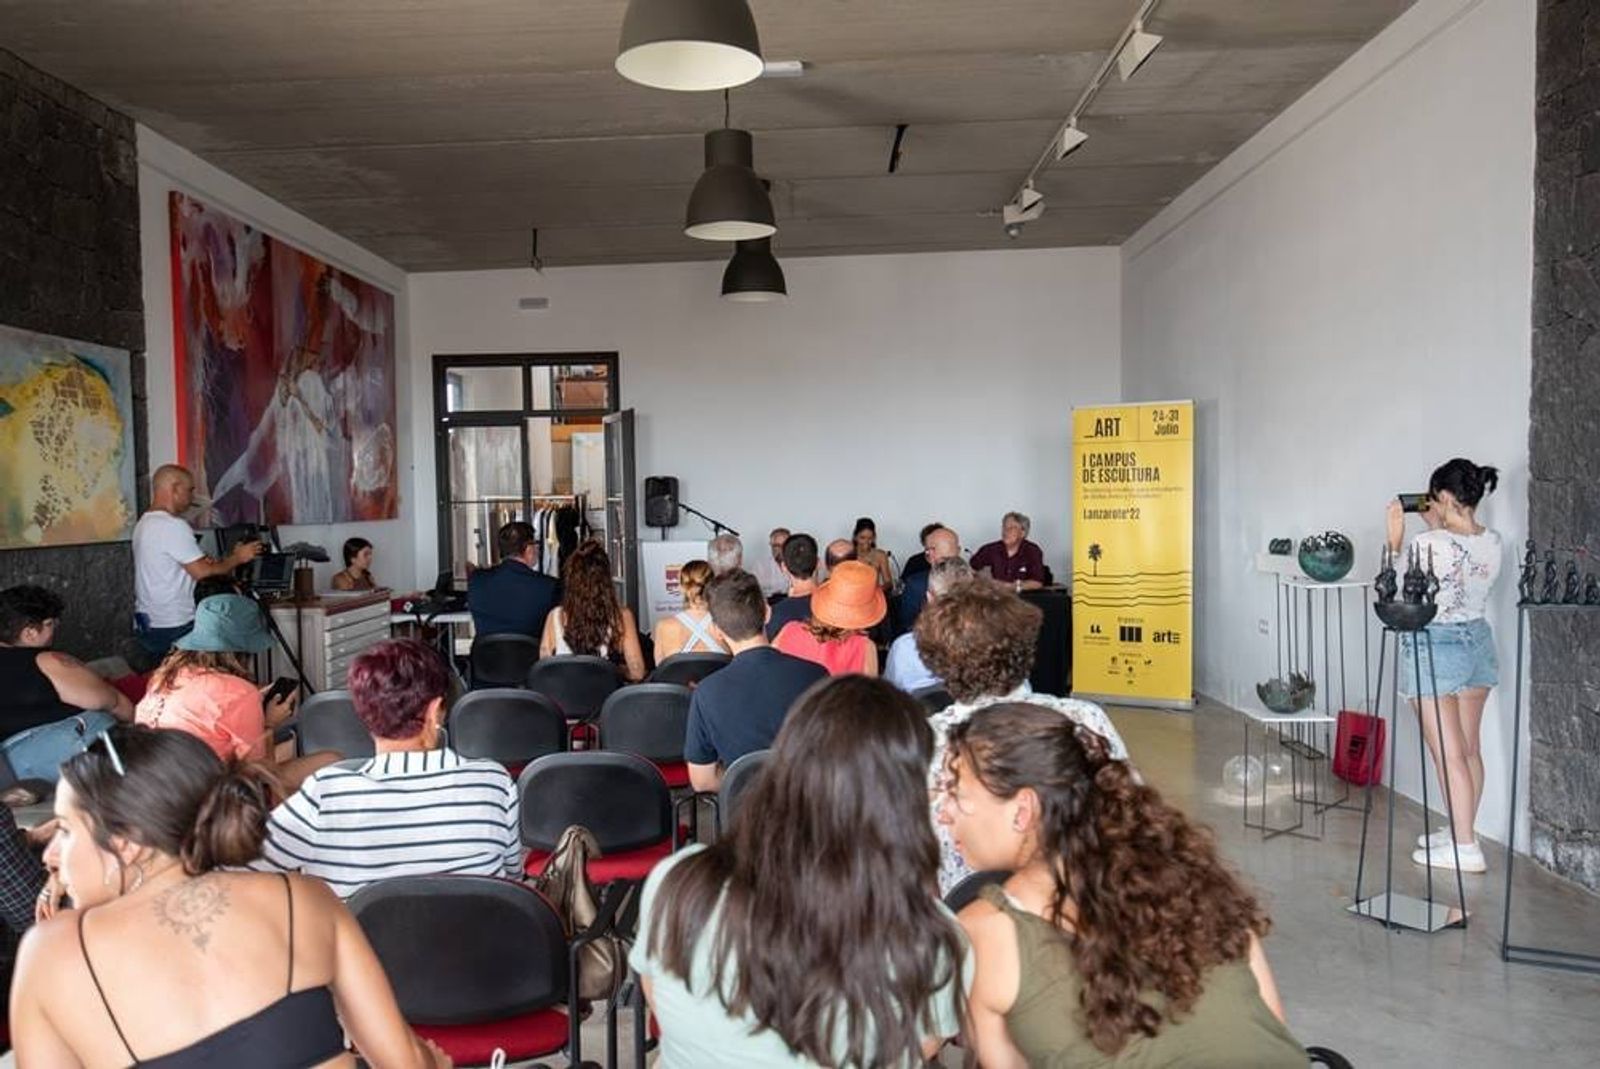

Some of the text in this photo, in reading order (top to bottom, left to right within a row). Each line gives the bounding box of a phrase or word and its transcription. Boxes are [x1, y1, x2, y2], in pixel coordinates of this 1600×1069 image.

[1154, 424, 1179, 436] Julio
[1089, 452, 1136, 467] CAMPUS
[1083, 467, 1160, 483] DE ESCULTURA
